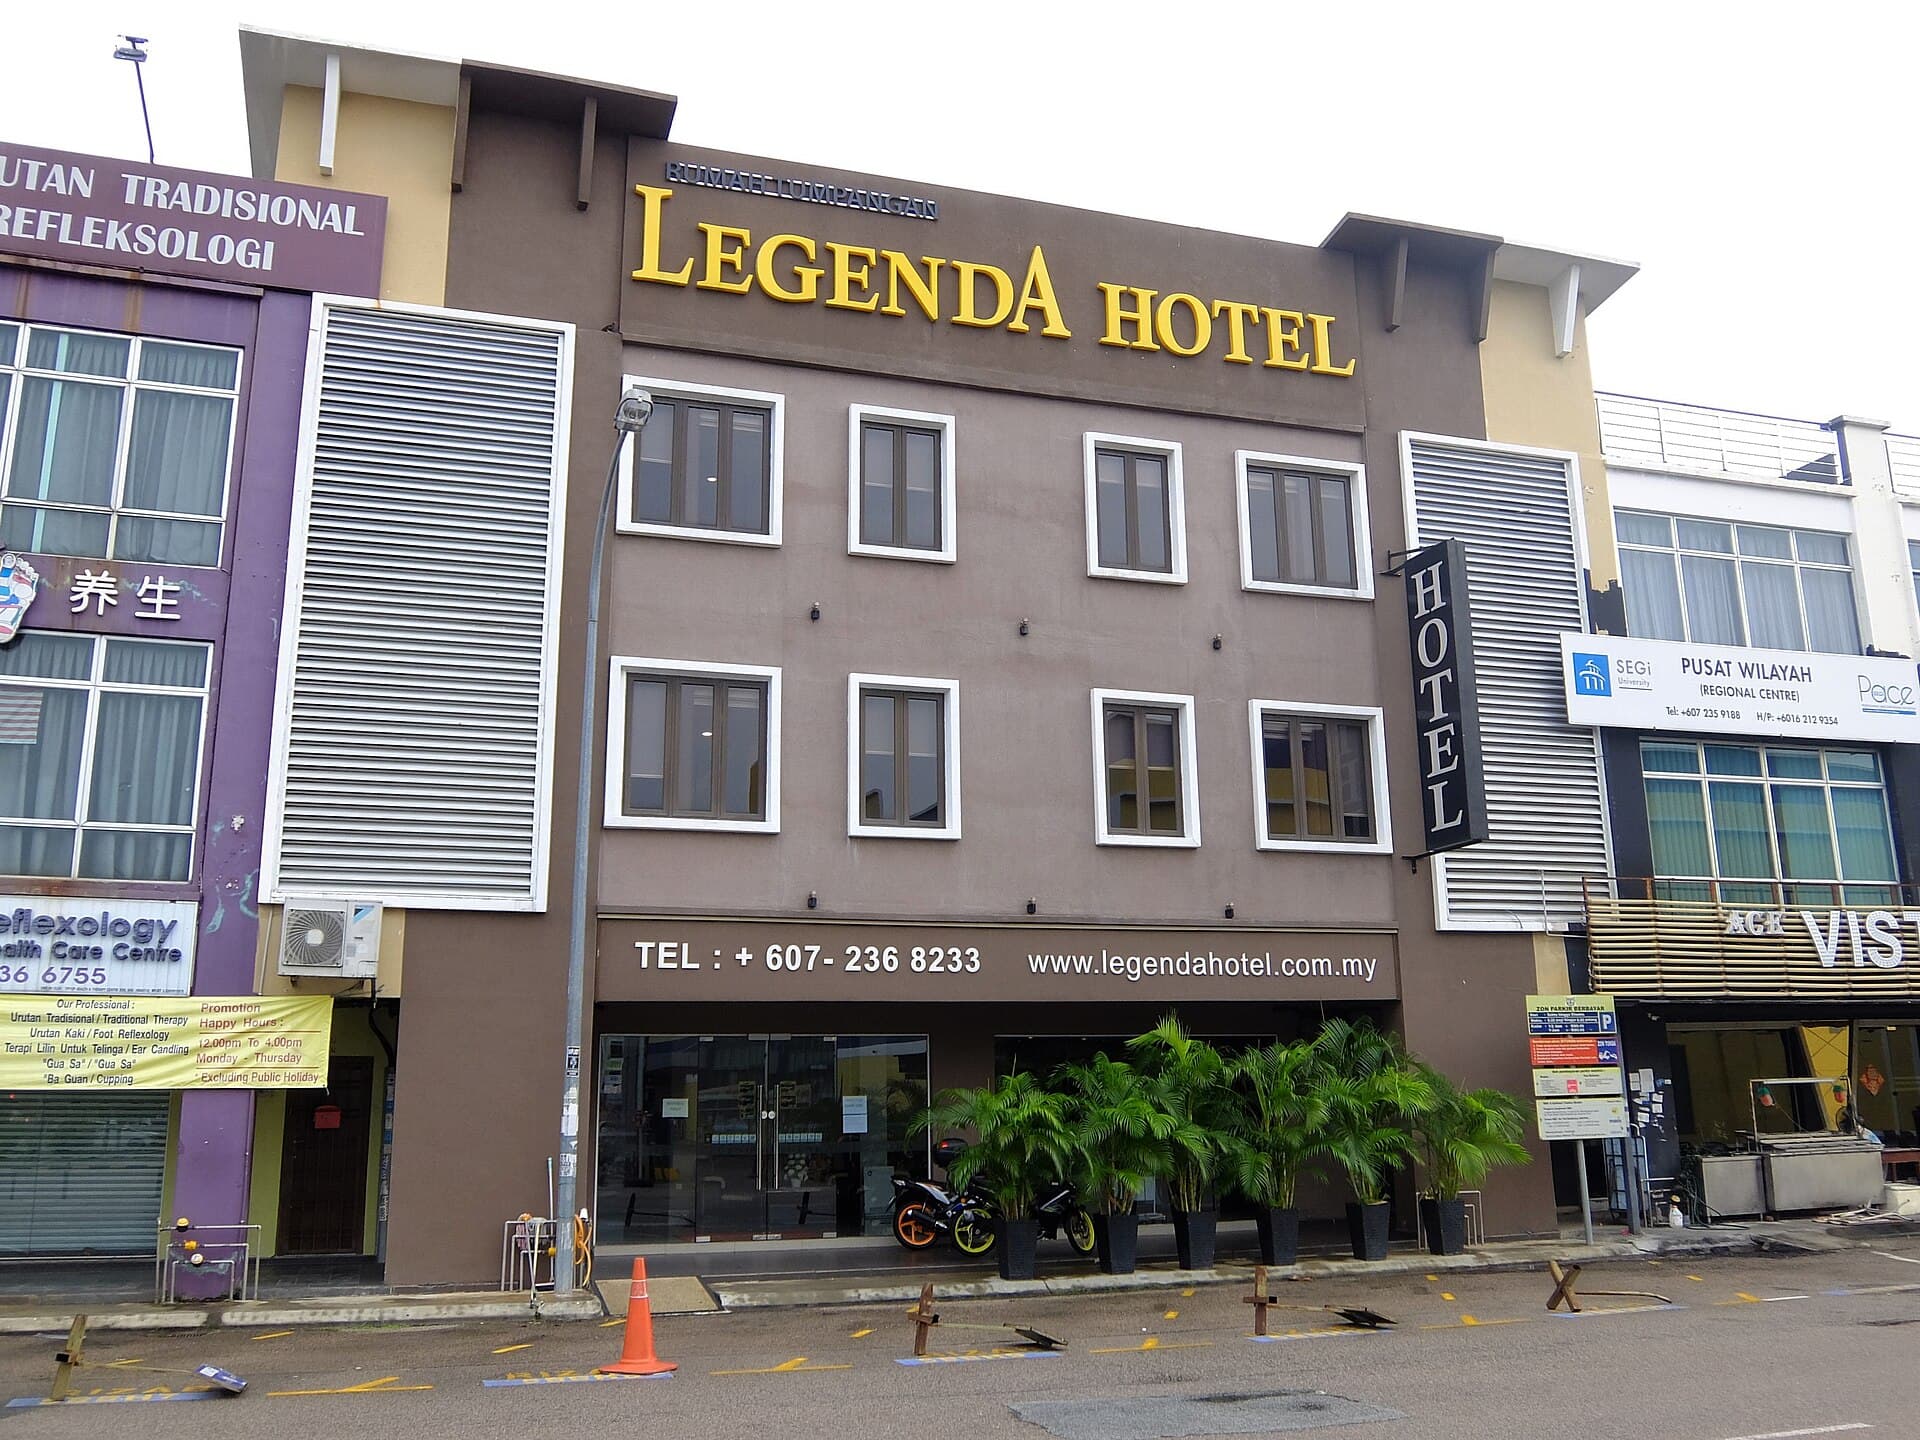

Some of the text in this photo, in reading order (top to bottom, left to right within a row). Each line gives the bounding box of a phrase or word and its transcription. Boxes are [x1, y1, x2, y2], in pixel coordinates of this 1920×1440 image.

[121, 173, 365, 236] TRADISIONAL
[631, 184, 1357, 378] LEGENDA HOTEL
[69, 569, 181, 620] 养生
[1616, 659, 1651, 676] SEGi
[1681, 657, 1812, 683] PUSAT WILAYAH
[1617, 676, 1650, 688] University
[1411, 560, 1463, 833] HOTEL
[1700, 684, 1800, 703] (REGIONAL CENTRE)
[1857, 674, 1915, 706] Pace
[1681, 708, 1700, 718] +607
[1703, 708, 1719, 719] 235
[1720, 709, 1741, 720] 9188
[1803, 714, 1817, 724] 212
[0, 939, 182, 962] alth Care Centre
[635, 942, 700, 969] TEL
[845, 945, 899, 972] 236
[910, 946, 981, 973] 8233
[1028, 949, 1377, 982] www.legendahotel.com.my
[41, 966, 106, 984] 6755
[57, 999, 73, 1009] Our
[75, 999, 131, 1010] Professional
[201, 1003, 261, 1013] Promotion
[10, 1012, 41, 1023] Urutan
[46, 1013, 94, 1024] Tradisional
[103, 1014, 148, 1025] Traditional
[153, 1014, 188, 1026] Therapy
[200, 1018, 236, 1030] Happy
[243, 1018, 277, 1028] Hours
[1603, 1014, 1612, 1030] P
[30, 1028, 60, 1038] Urutan
[65, 1028, 85, 1038] Kaki
[93, 1028, 113, 1039] Foot
[118, 1029, 169, 1041] Reflexology
[248, 1037, 259, 1047] To
[5, 1043, 32, 1054] Terapi
[37, 1043, 56, 1053] Lilin
[60, 1043, 87, 1054] Untuk
[92, 1044, 123, 1056] Telinga
[132, 1044, 146, 1054] Ear
[151, 1045, 189, 1056] Candling
[196, 1053, 238, 1064] Monday
[254, 1052, 302, 1064] Thursday
[64, 1074, 88, 1084] Guan
[97, 1074, 133, 1086] Cupping
[201, 1072, 319, 1084] Excluding Public Holiday
